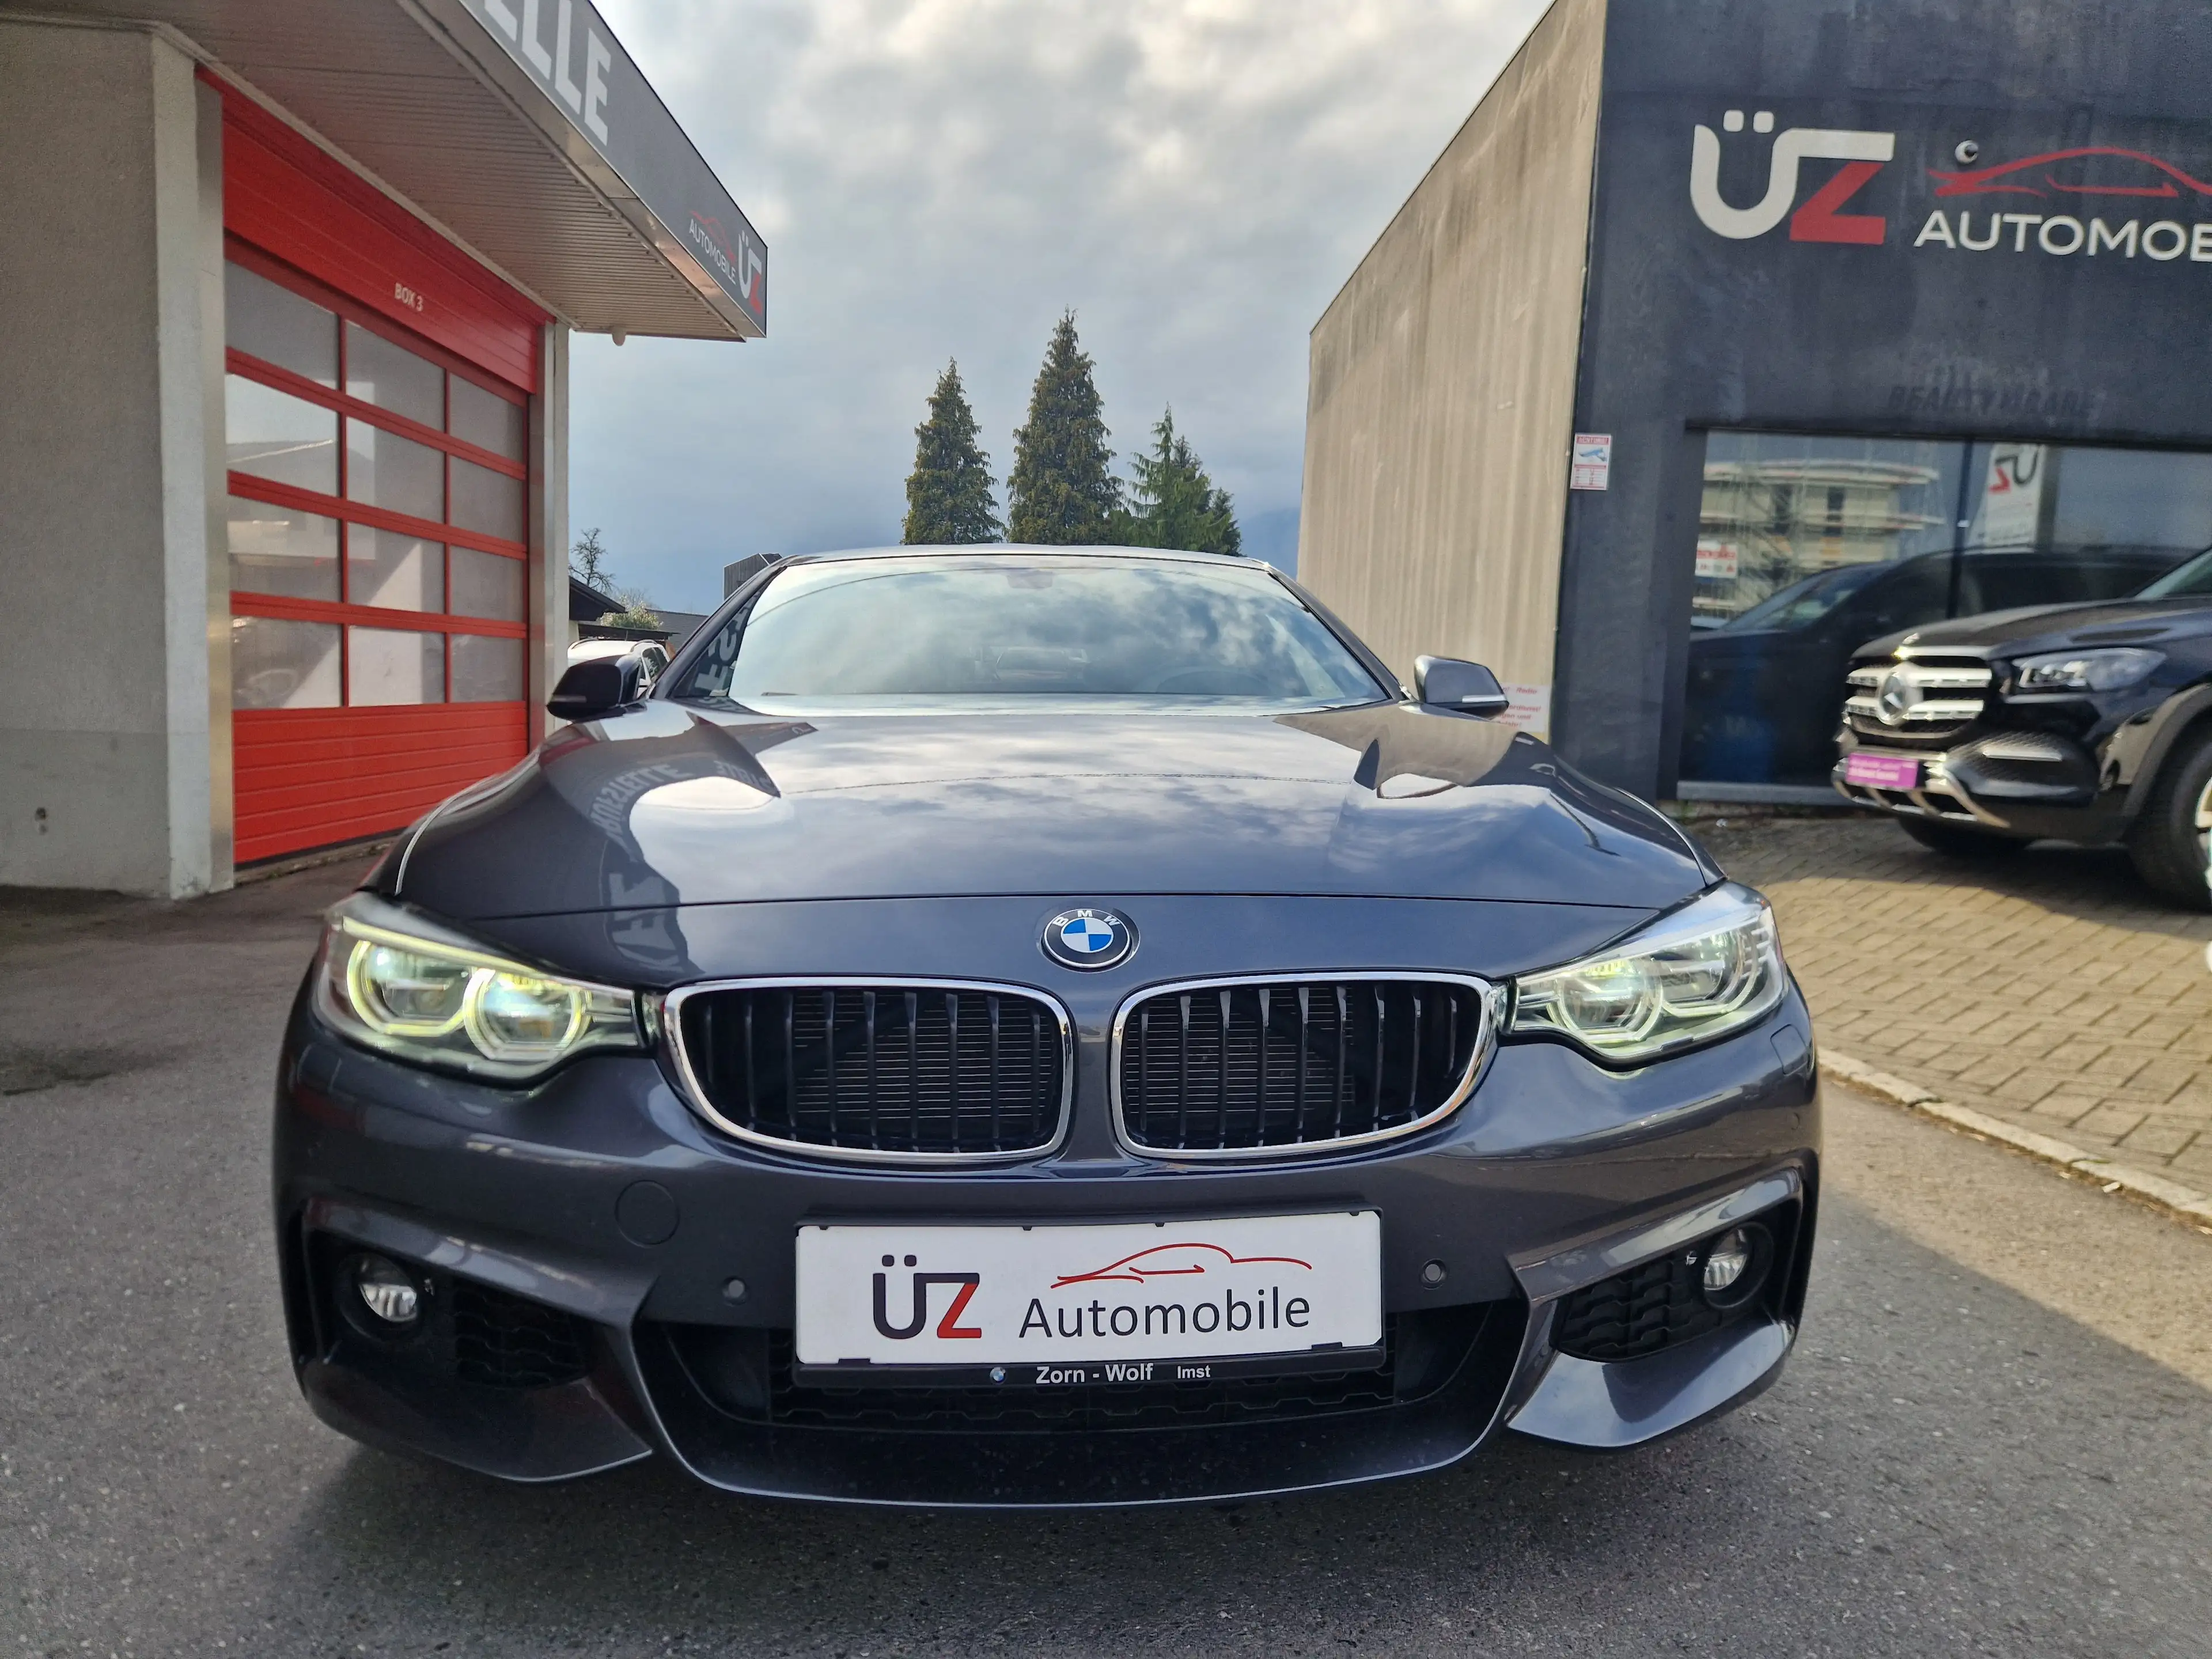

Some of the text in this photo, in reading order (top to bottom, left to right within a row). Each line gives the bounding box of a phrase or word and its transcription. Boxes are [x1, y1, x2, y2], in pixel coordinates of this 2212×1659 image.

[1690, 109, 1895, 245] ÜZ
[688, 218, 737, 286] AUTOMOBILE
[738, 230, 763, 316] ÜZ
[395, 282, 423, 312] BOX 3
[1052, 909, 1121, 927] BMW
[872, 1253, 982, 1340] ÜZ
[1018, 1286, 1310, 1338] Automobile
[1036, 1366, 1085, 1384] Zorn
[1104, 1362, 1154, 1382] Wolf
[1177, 1365, 1211, 1380] Imst
